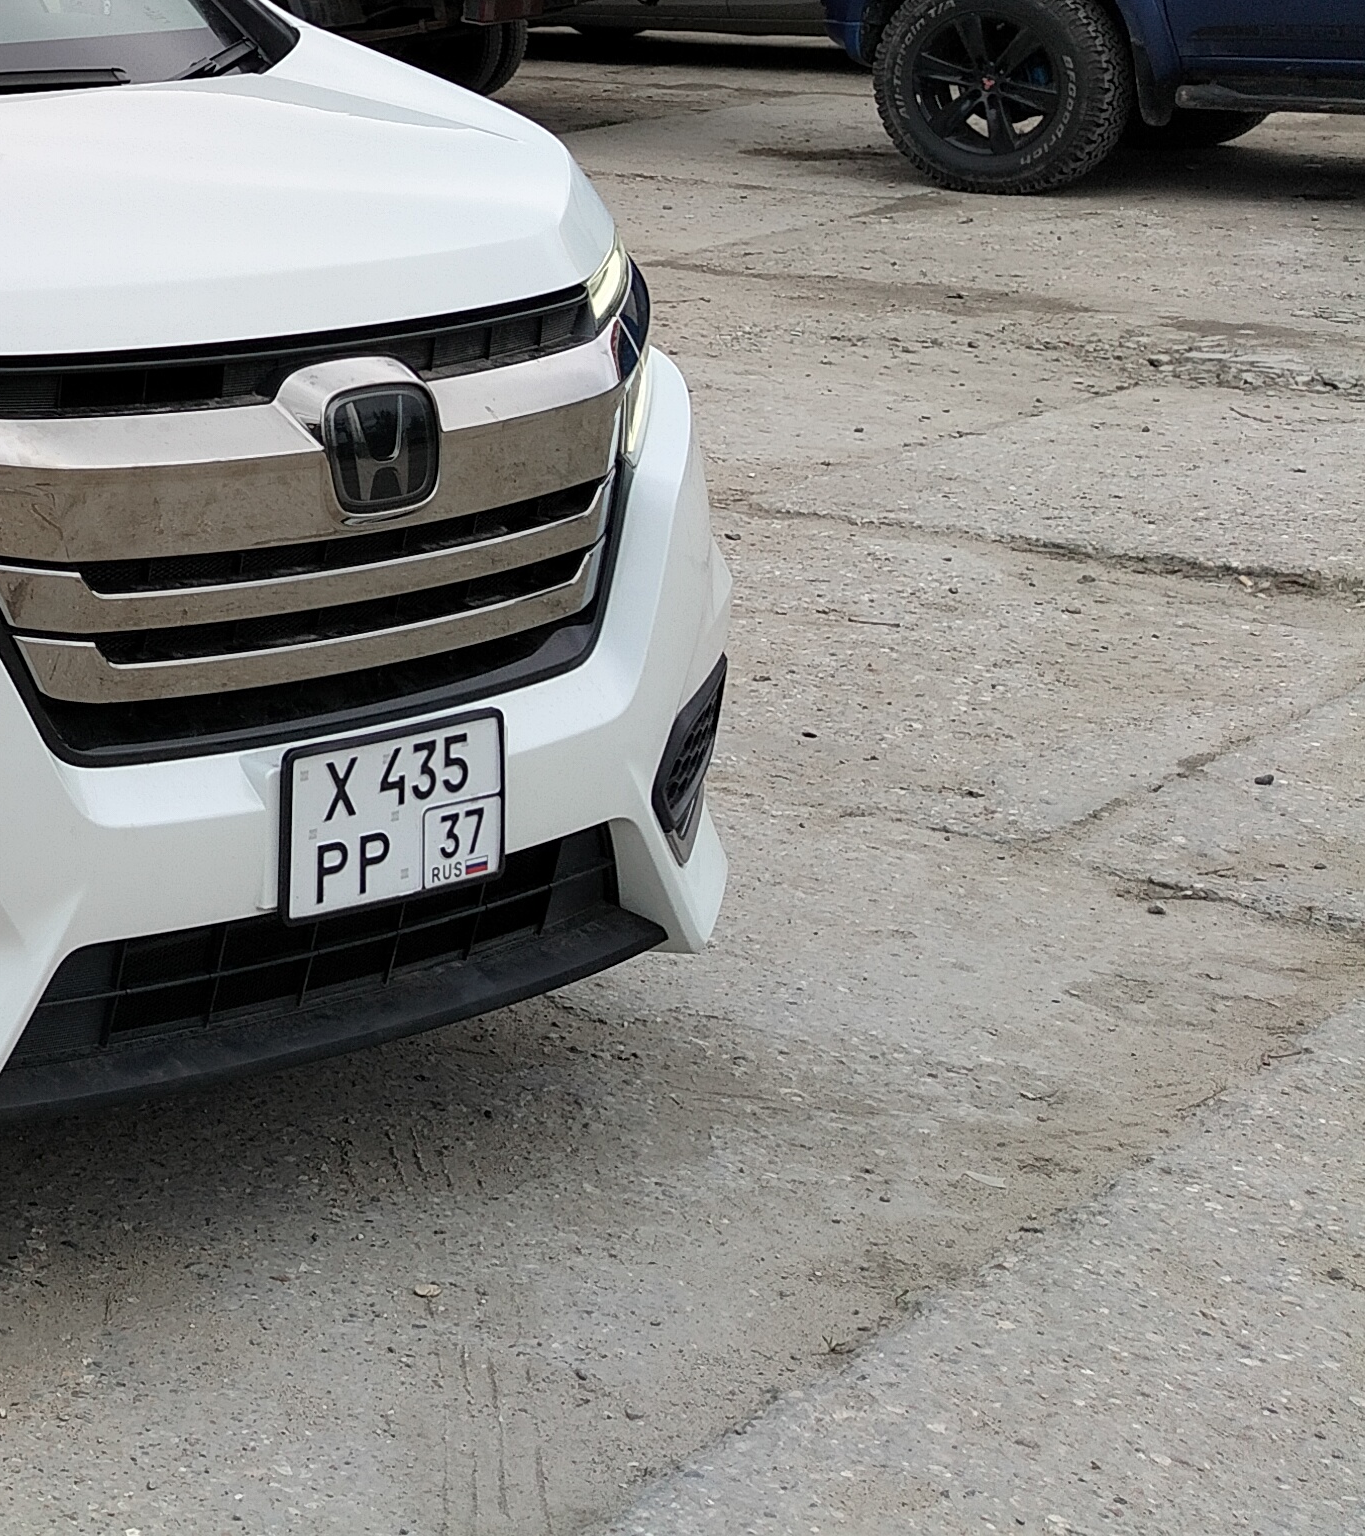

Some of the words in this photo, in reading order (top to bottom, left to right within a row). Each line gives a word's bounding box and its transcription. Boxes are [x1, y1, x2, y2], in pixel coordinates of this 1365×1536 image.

[379, 732, 469, 806] 435
[440, 807, 485, 859] 37
[431, 861, 463, 884] RUS
